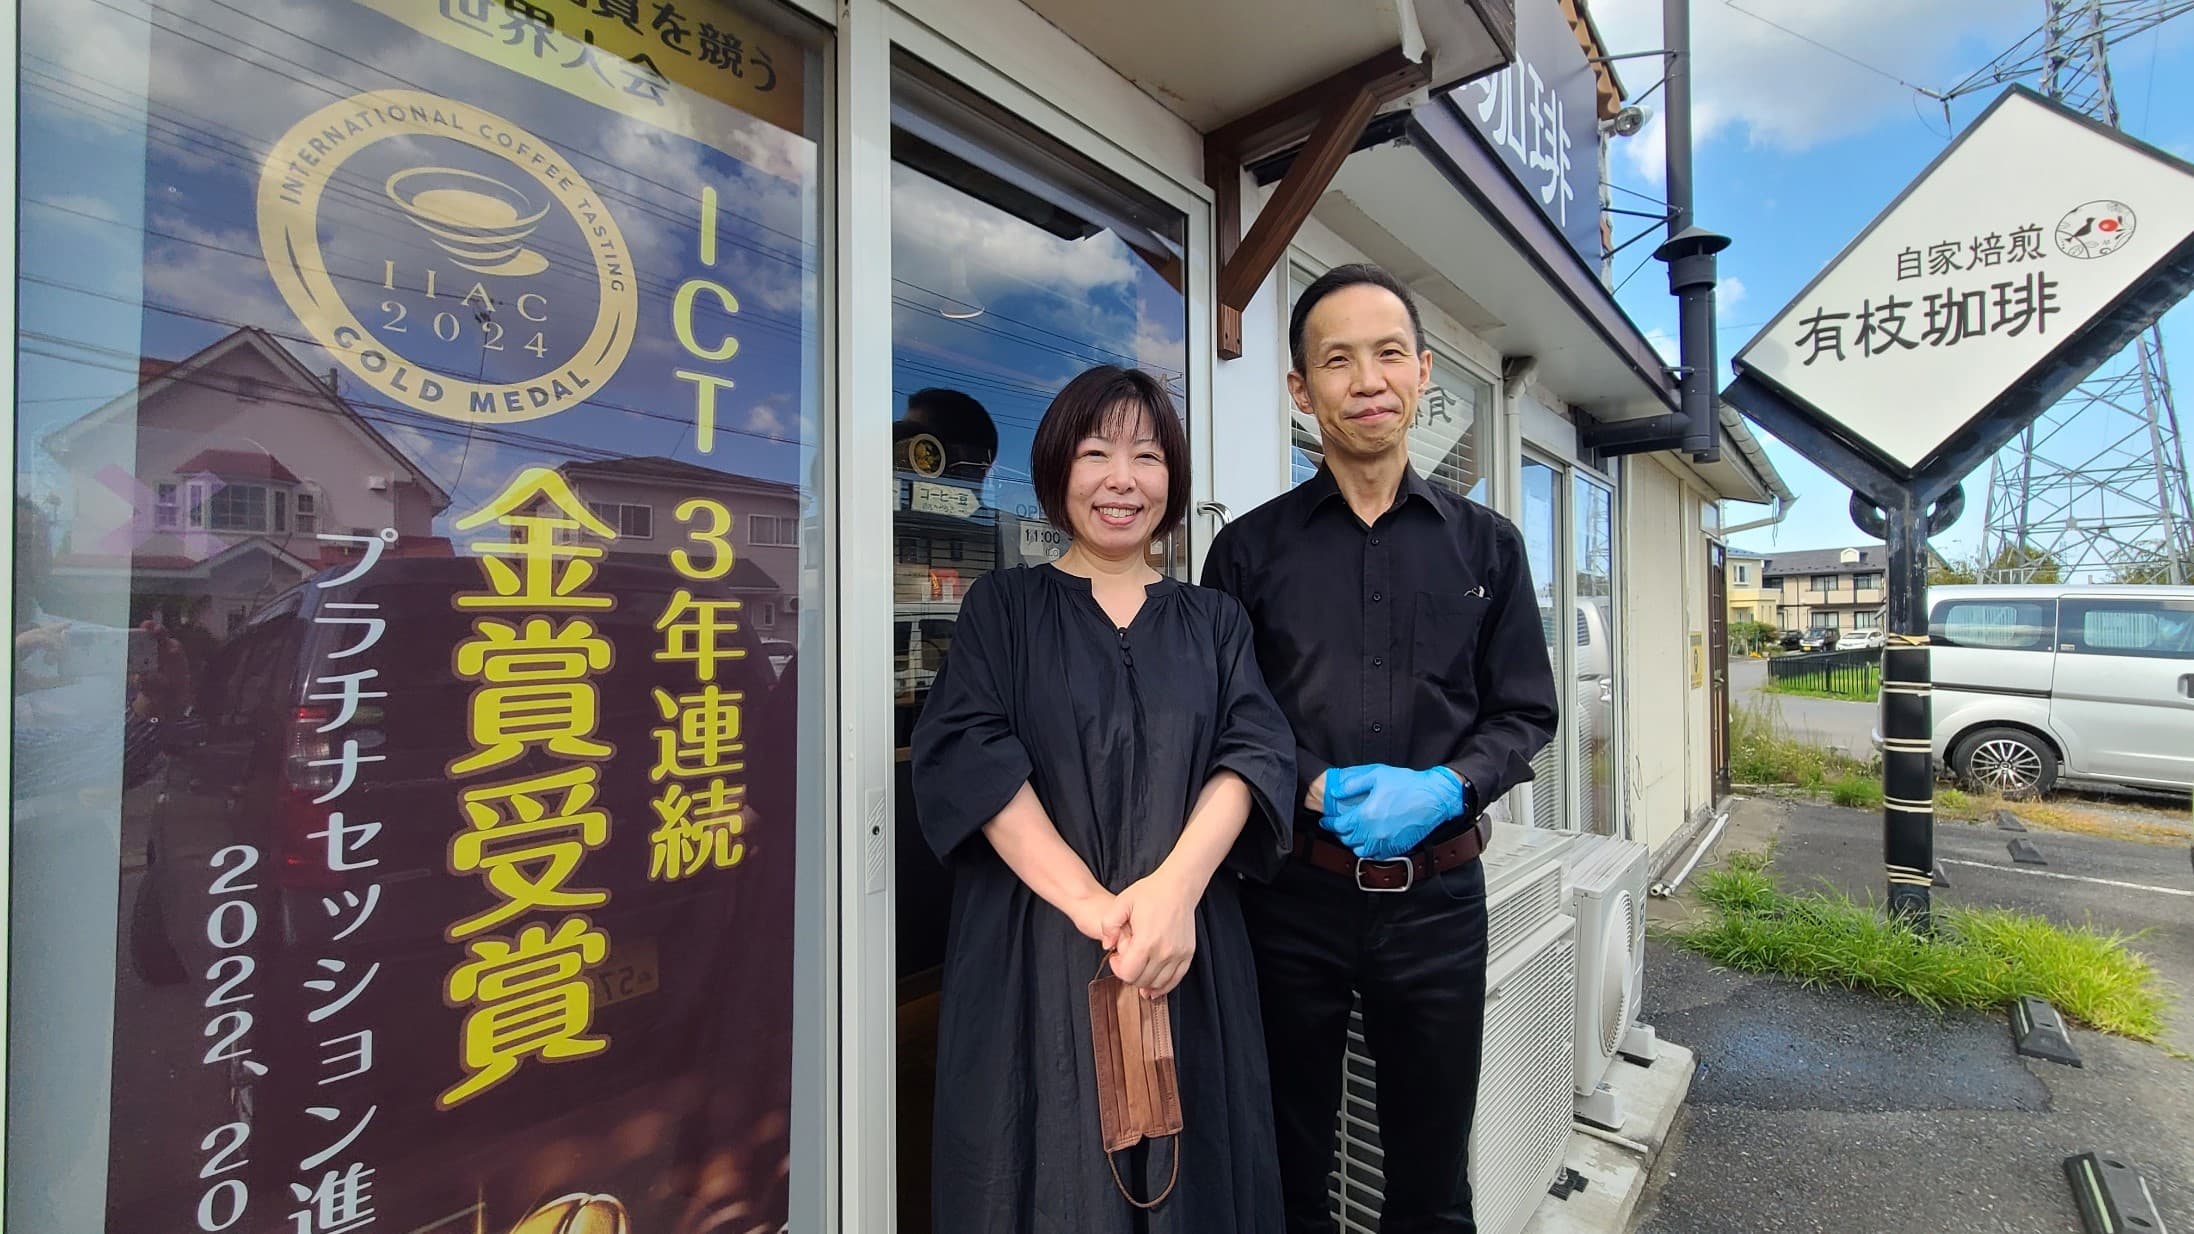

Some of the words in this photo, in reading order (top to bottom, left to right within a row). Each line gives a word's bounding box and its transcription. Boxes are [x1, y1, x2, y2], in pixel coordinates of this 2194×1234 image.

[437, 0, 671, 106] 世界大会
[280, 103, 464, 205] INTERNATIONAL
[479, 124, 572, 192] COFFEE
[577, 198, 625, 293] TASTING
[1896, 223, 2048, 282] 自家焙煎
[381, 300, 548, 359] 2024
[672, 184, 741, 456] ICT
[1795, 270, 2062, 367] 有枝珈琲
[469, 369, 590, 414] MEDAL
[1025, 529, 1061, 544] 11:00
[647, 498, 748, 882] 3年連続
[434, 466, 619, 1112] 金賞受賞
